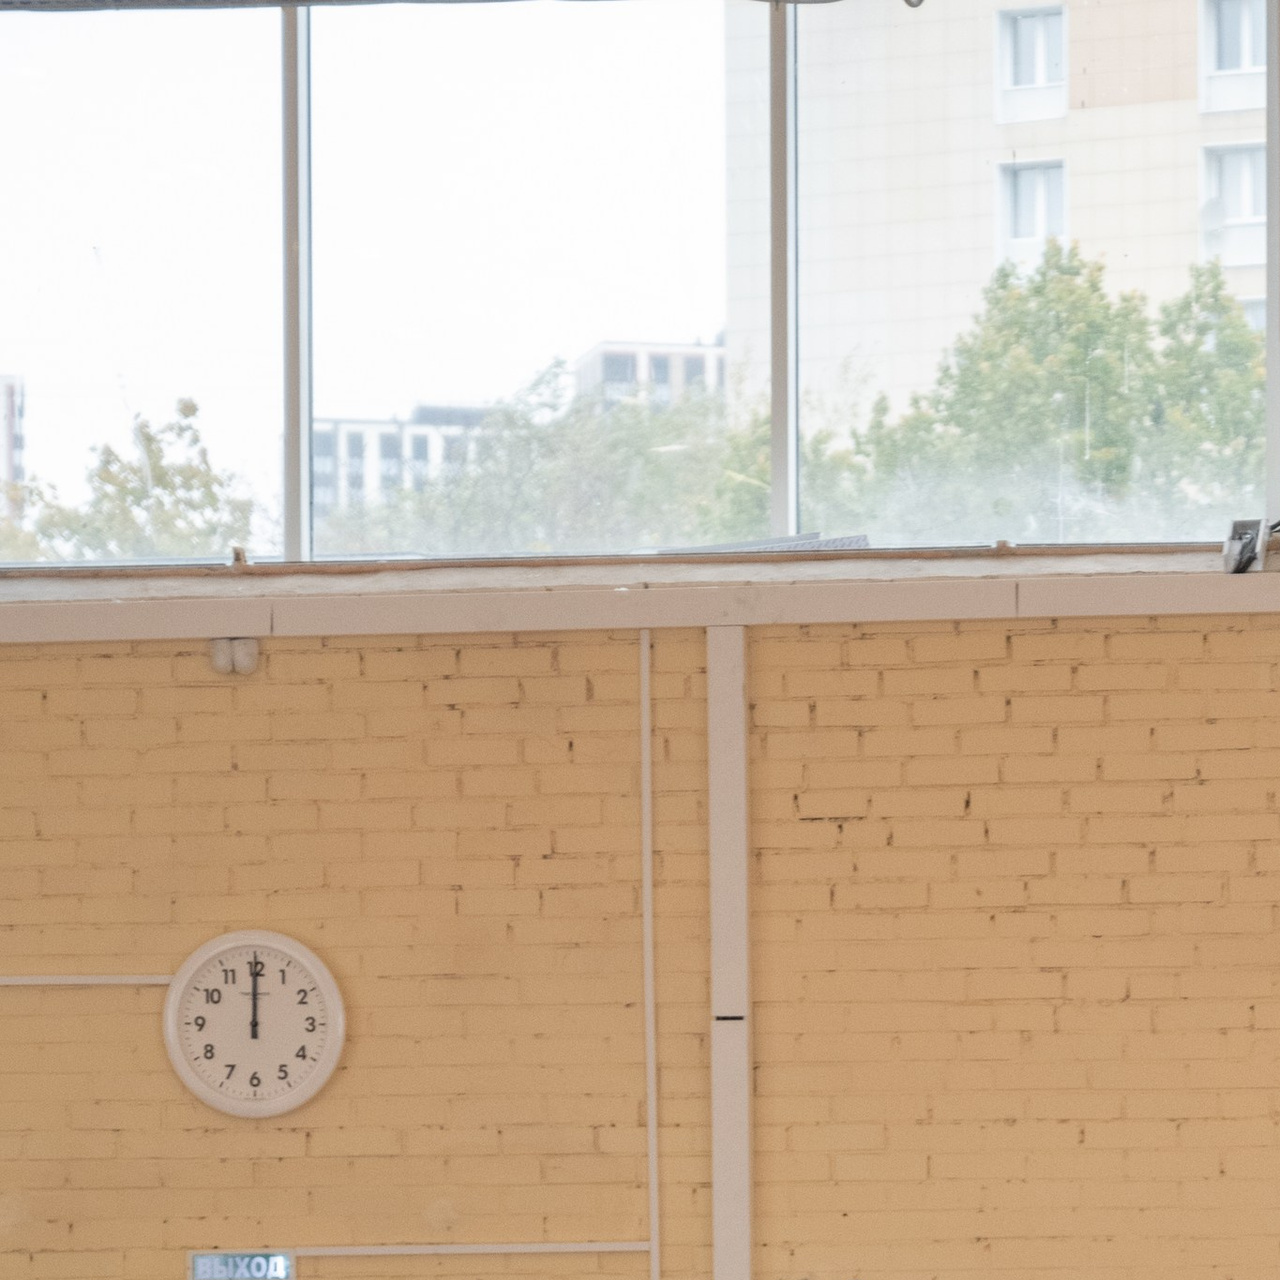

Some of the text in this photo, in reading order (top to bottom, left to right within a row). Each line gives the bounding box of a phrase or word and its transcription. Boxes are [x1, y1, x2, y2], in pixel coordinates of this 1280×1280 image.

[222, 969, 236, 984] 11
[247, 961, 265, 977] 12
[279, 969, 286, 984] 1
[203, 988, 221, 1004] 10
[297, 989, 308, 1005] 2
[194, 1016, 206, 1031] 9
[305, 1016, 316, 1032] 3
[203, 1044, 215, 1060] 8
[295, 1045, 307, 1060] 4
[225, 1064, 236, 1079] 7
[249, 1071, 261, 1087] 6
[277, 1064, 289, 1080] 5
[196, 1256, 287, 1279] ВЫХОД
